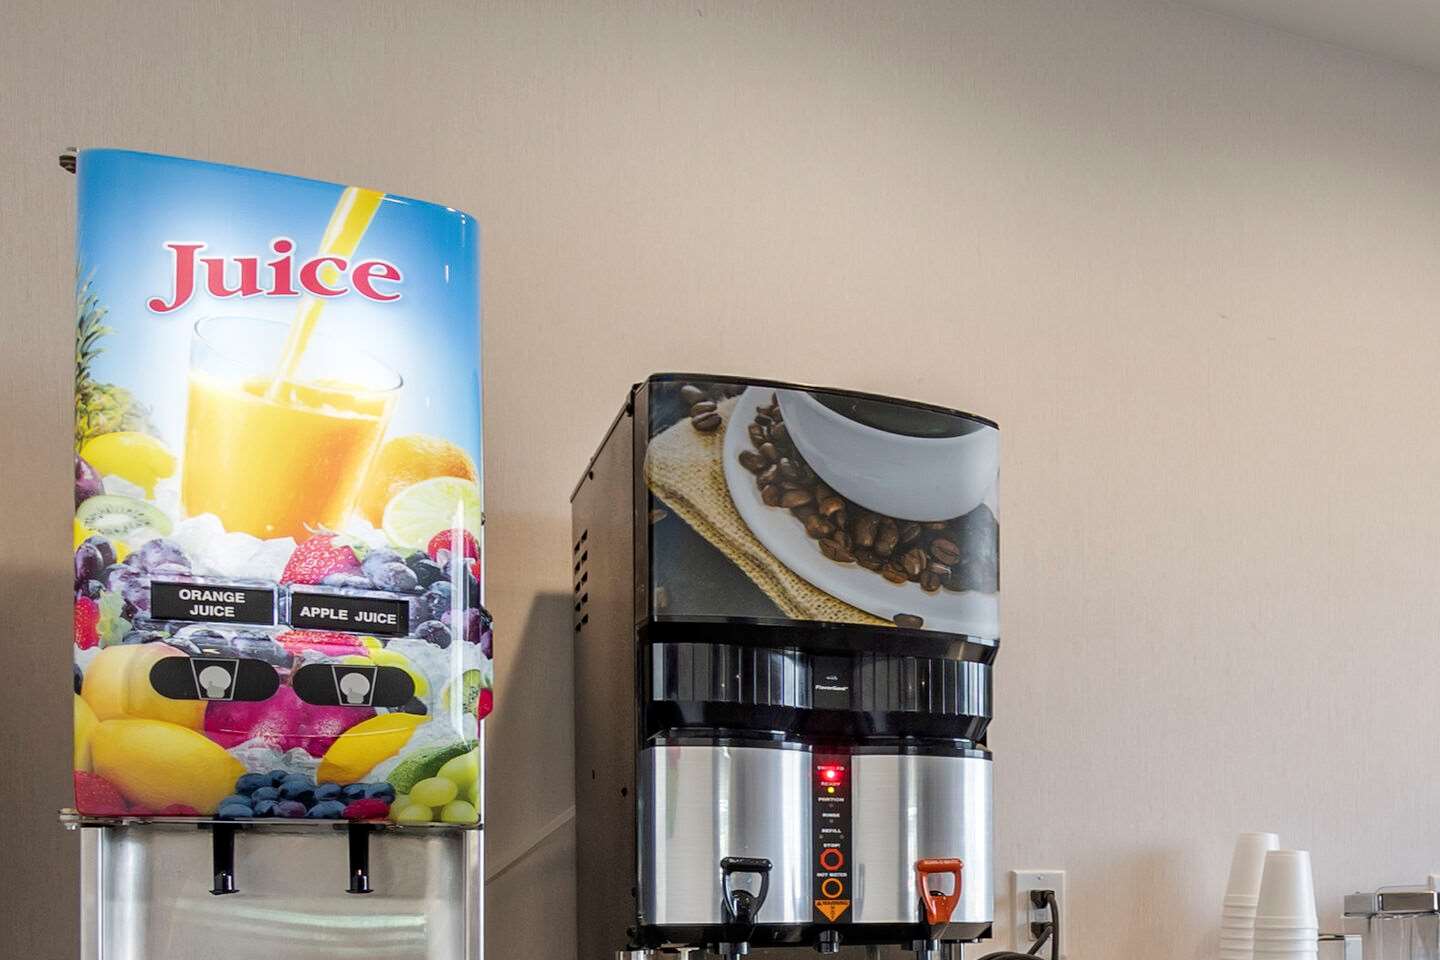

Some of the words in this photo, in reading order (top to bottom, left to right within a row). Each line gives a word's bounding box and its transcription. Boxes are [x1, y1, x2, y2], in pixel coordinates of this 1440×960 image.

[149, 238, 402, 312] Juice
[178, 588, 246, 604] ORANGE
[189, 605, 236, 618] JUICE
[300, 606, 349, 621] APPLE
[354, 611, 398, 625] JUICE
